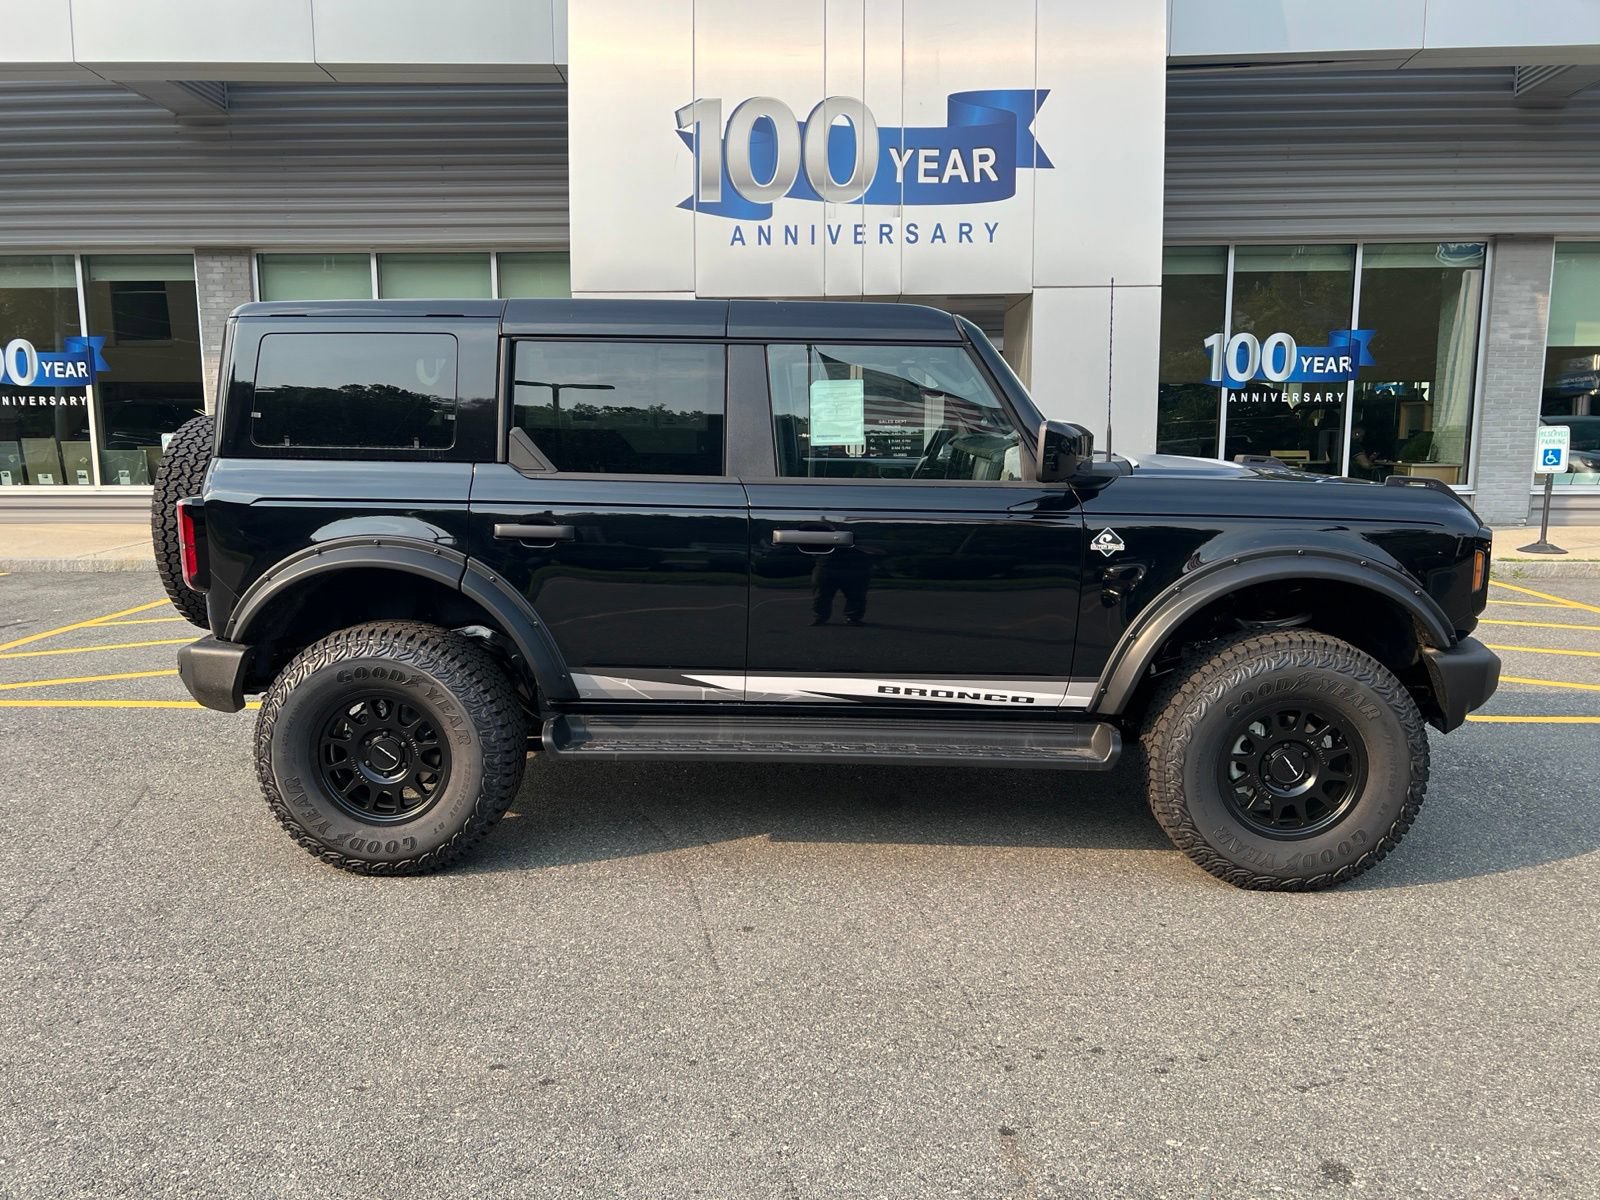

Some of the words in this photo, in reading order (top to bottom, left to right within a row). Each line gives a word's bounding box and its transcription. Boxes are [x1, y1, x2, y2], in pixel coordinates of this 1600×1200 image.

[675, 95, 880, 204] 100
[888, 147, 999, 184] YEAR
[729, 222, 1000, 246] ANNIVERSARY
[1203, 332, 1298, 382] 100
[1301, 356, 1353, 374] YEAR
[41, 361, 89, 378] YEAR
[1228, 392, 1345, 403] ANNIVERSARY
[877, 685, 1035, 704] BRONCO
